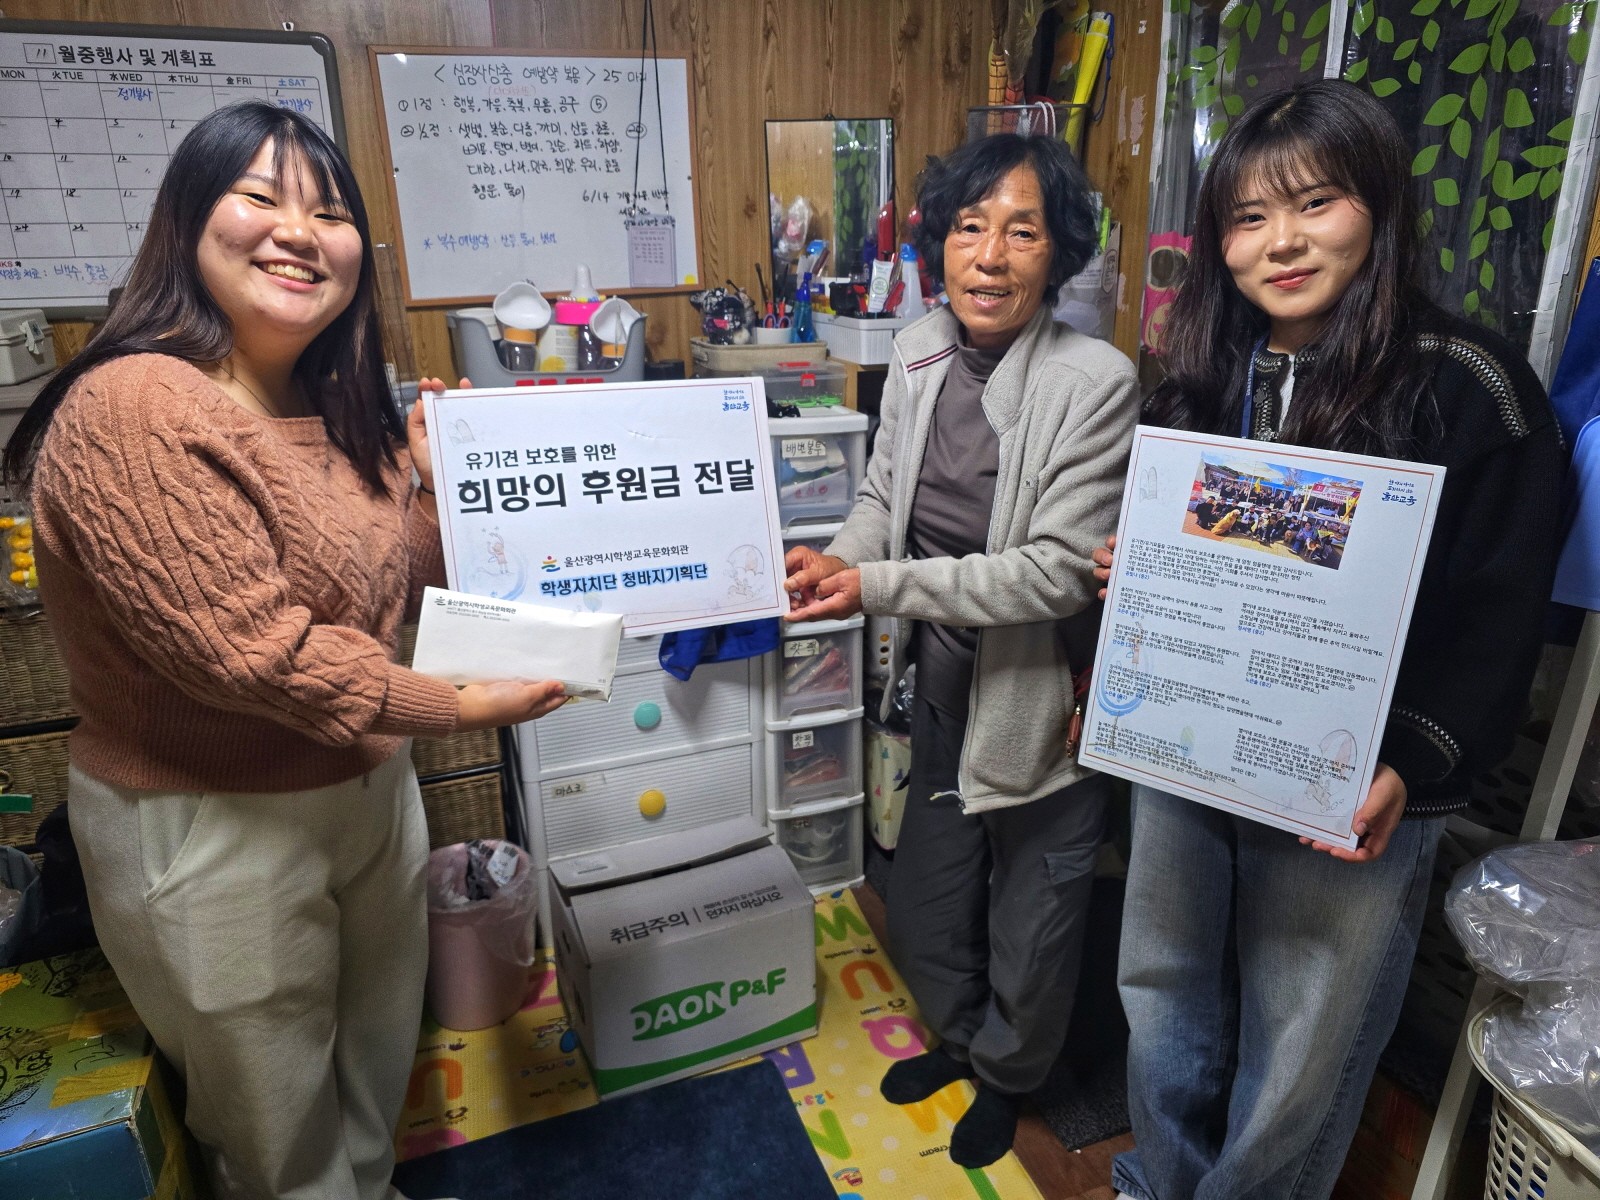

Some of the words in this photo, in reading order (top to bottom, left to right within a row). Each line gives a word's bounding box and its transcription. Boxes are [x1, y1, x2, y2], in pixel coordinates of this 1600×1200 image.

[58, 45, 133, 66] 월중행사
[139, 48, 157, 66] 및
[161, 49, 216, 68] 계획표
[522, 65, 558, 85] 예방약
[603, 69, 622, 83] 25
[466, 450, 519, 471] 유기견
[526, 445, 578, 466] 보호를
[583, 443, 617, 463] 위한
[457, 473, 568, 515] 희망의
[581, 463, 682, 505] 후원금
[694, 458, 756, 495] 전달
[564, 544, 690, 568] 울산광역시학생교육문화회관
[540, 573, 618, 597] 학생자치단
[622, 564, 708, 591] 청바지기획단
[706, 903, 740, 920] 던지지
[741, 891, 784, 909] 마십시오
[609, 911, 690, 944] 취급주의
[631, 981, 727, 1042] DAON
[729, 967, 787, 1007] P&F
